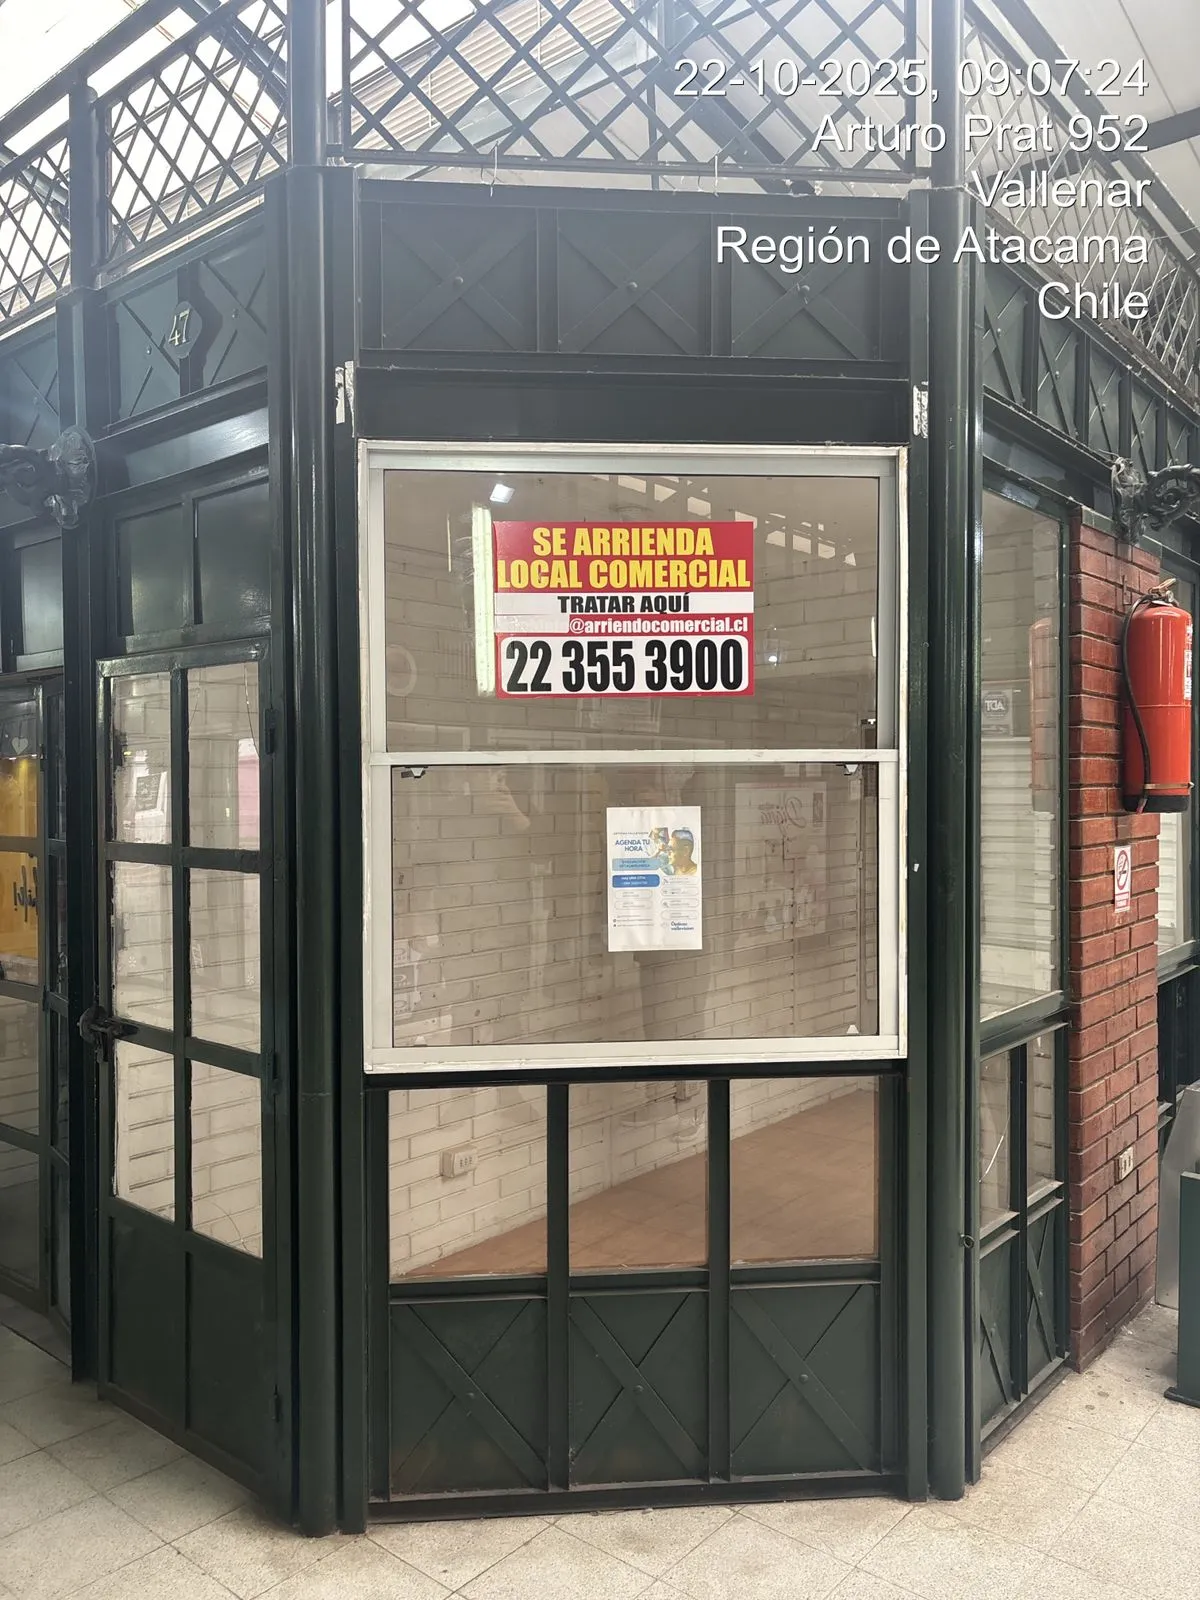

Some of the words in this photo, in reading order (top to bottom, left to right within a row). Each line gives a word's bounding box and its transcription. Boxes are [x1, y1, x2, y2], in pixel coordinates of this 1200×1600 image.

[168, 308, 191, 346] 47
[532, 527, 566, 556] SE
[572, 527, 714, 556] ARRIENDA
[497, 559, 582, 589] LOCAL
[589, 559, 751, 588] COMERCIAL
[557, 595, 635, 613] TRATAR
[640, 592, 690, 614] AQUÍ
[569, 617, 748, 633] @arriendocomercial.cl
[506, 640, 552, 692] 22
[561, 639, 635, 691] 355
[645, 638, 743, 691] 3900
